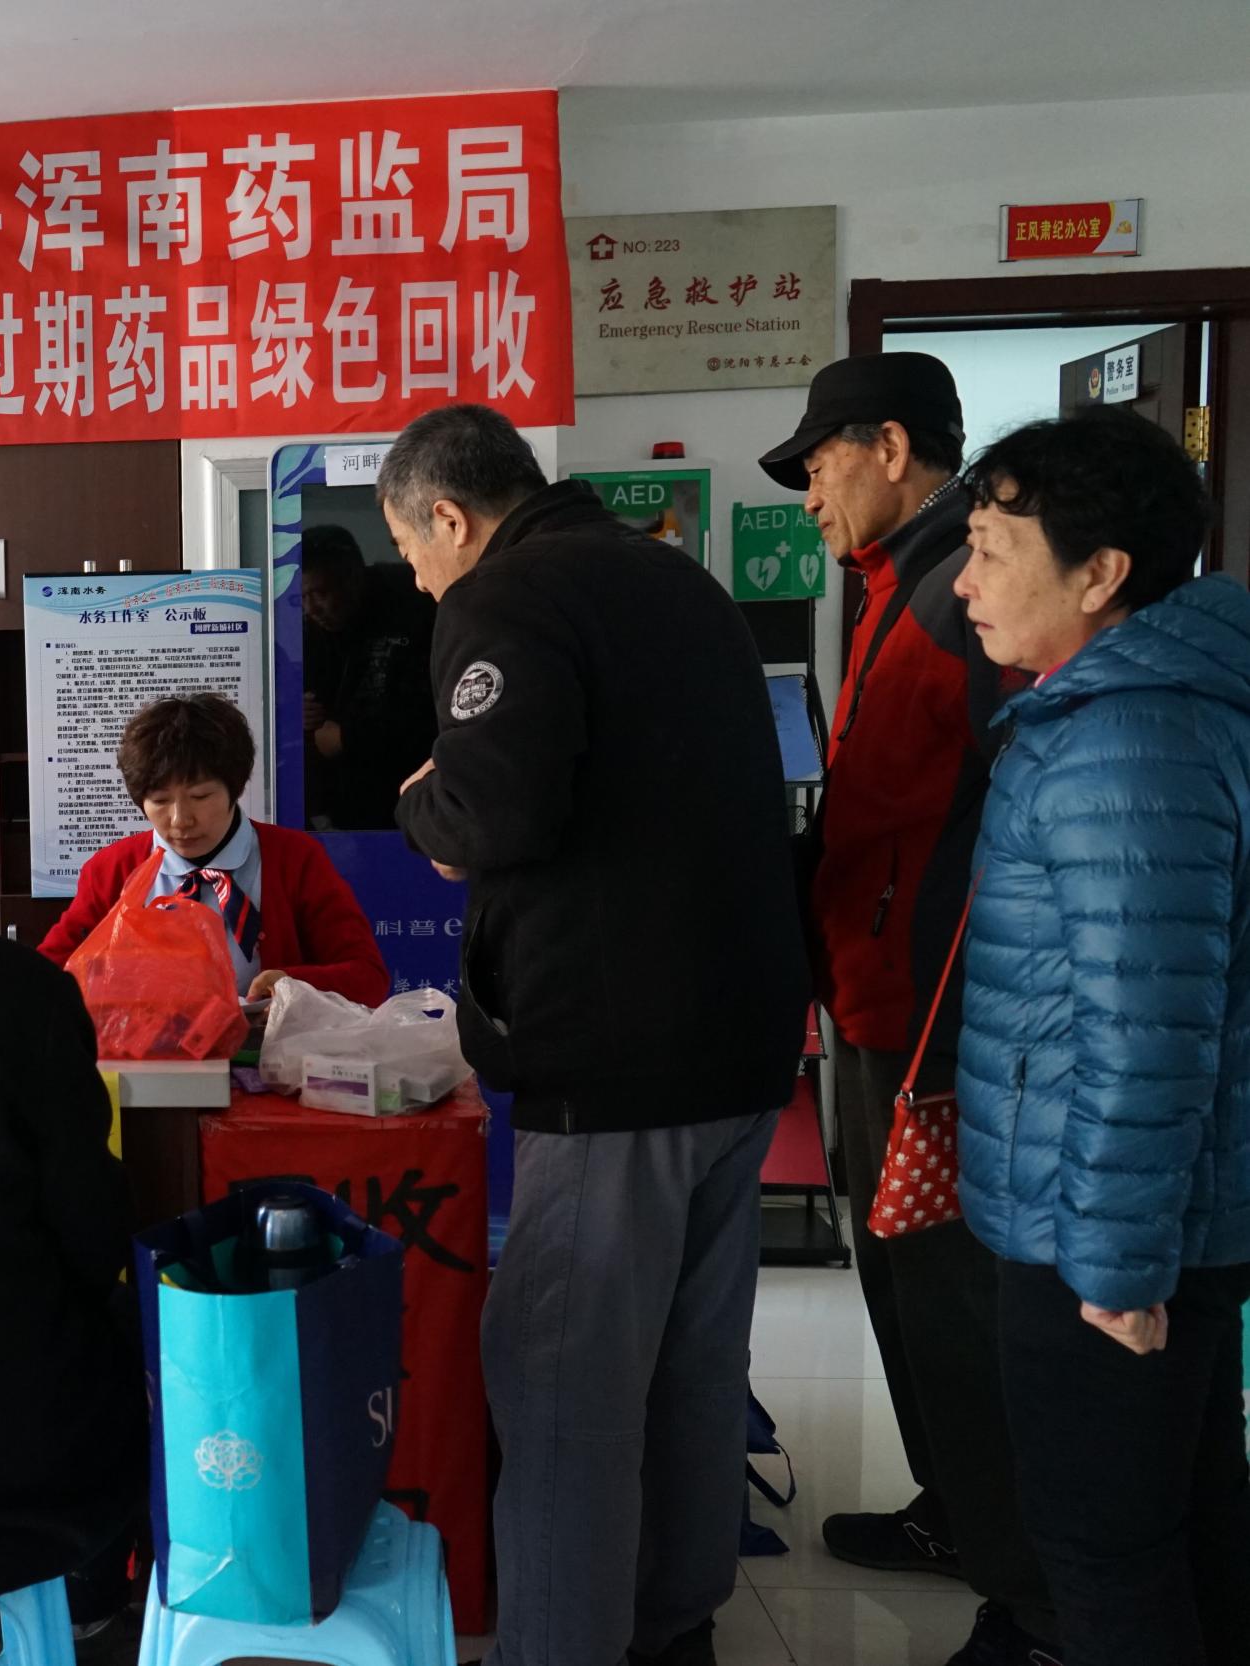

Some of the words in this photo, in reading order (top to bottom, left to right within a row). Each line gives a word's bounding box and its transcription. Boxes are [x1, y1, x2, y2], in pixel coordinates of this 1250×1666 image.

[1016, 217, 1101, 241] 正风肃纪办公室
[623, 241, 651, 254] NO:
[655, 239, 681, 252] 223
[598, 272, 802, 313] 应急救护站
[598, 321, 683, 340] Emergency
[686, 319, 742, 335] Rescue
[746, 317, 801, 333] Station
[1106, 355, 1134, 382] 警务室
[342, 452, 387, 471] 河畔
[612, 484, 665, 505] AED
[739, 509, 787, 531] AED
[79, 608, 150, 624] 水务工作室
[165, 607, 207, 622] 公示板
